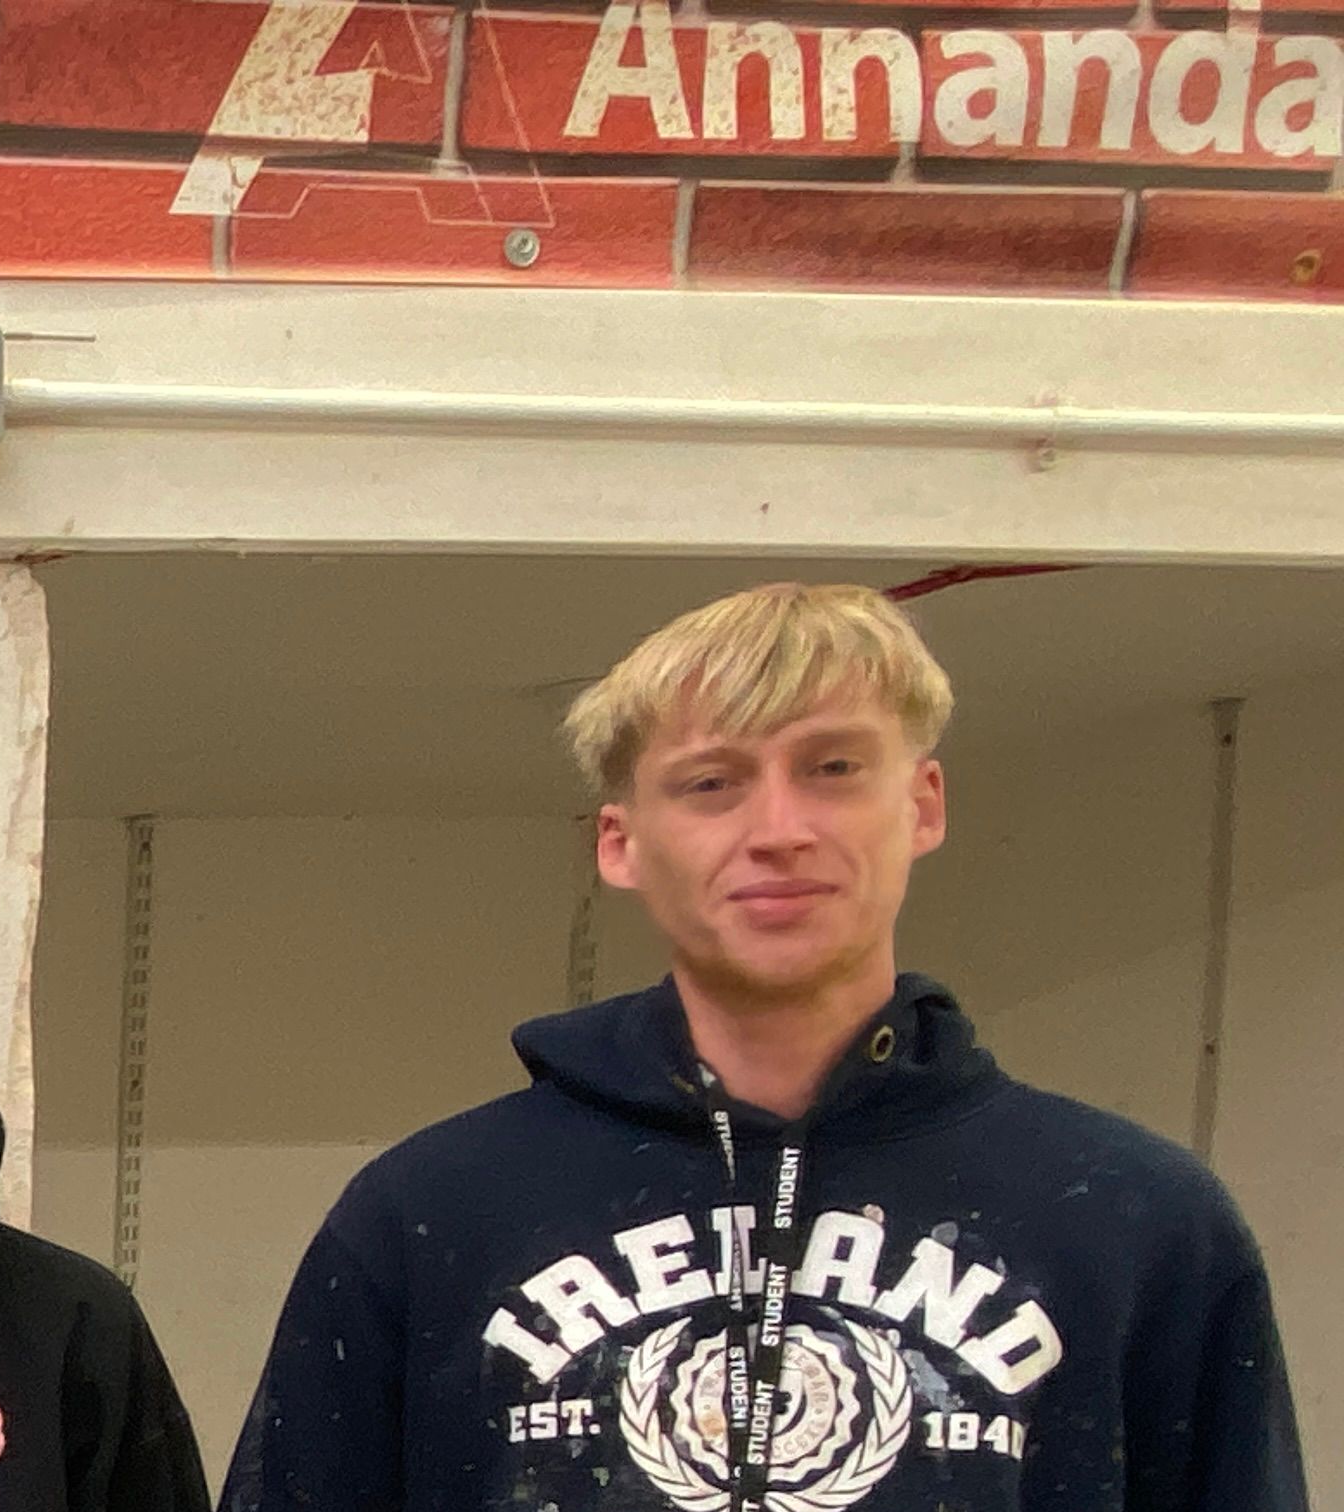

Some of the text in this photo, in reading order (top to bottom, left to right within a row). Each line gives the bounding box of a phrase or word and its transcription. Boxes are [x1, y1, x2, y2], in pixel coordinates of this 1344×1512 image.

[562, 0, 1344, 156] Annanda
[774, 1146, 802, 1229] STUDENT
[482, 1203, 1063, 1395] IRELAND
[762, 1264, 788, 1348] STUDENT
[508, 1399, 601, 1443] EST.
[748, 1380, 776, 1465] STUDENT
